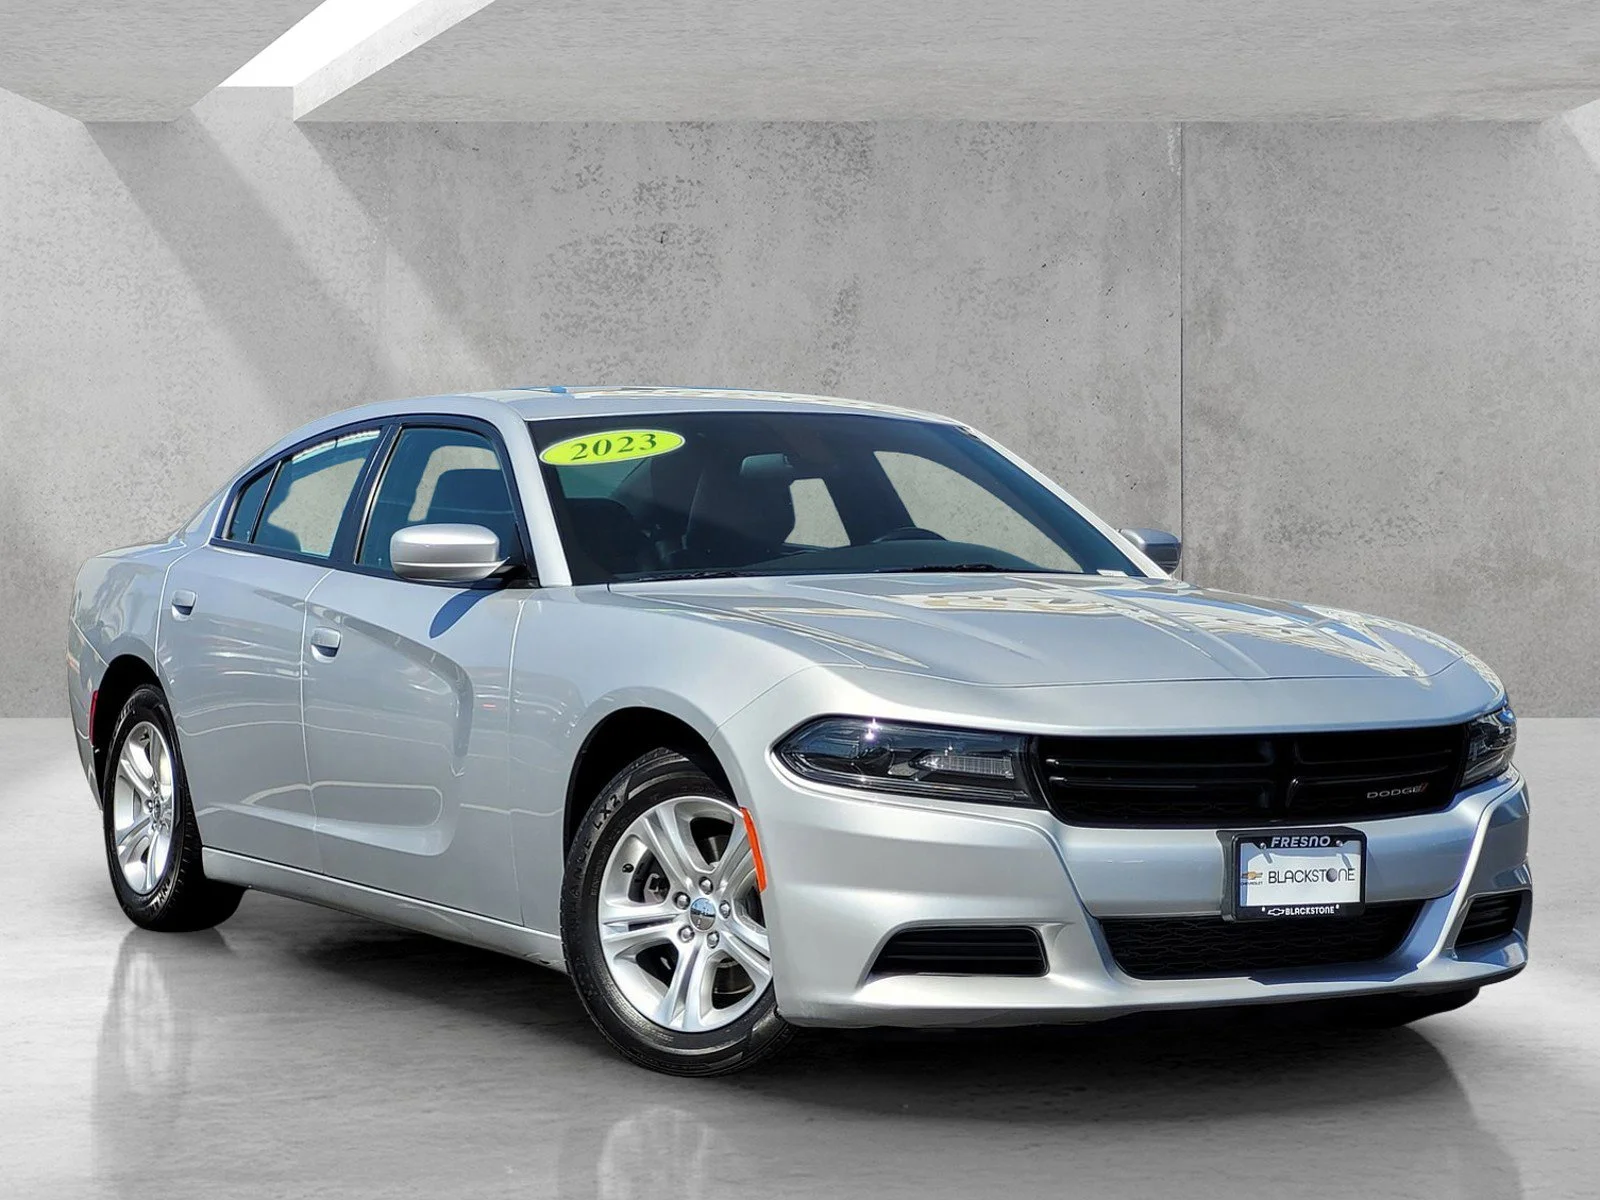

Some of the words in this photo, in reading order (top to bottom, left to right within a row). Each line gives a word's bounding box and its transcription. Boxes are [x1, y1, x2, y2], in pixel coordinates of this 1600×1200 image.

[570, 433, 657, 460] 2023
[1366, 785, 1422, 798] DODGE
[592, 794, 621, 830] LX2
[1270, 835, 1331, 848] FRESNO
[1268, 867, 1356, 884] BLACKSTONE
[1284, 905, 1335, 916] BLACKSTONE
